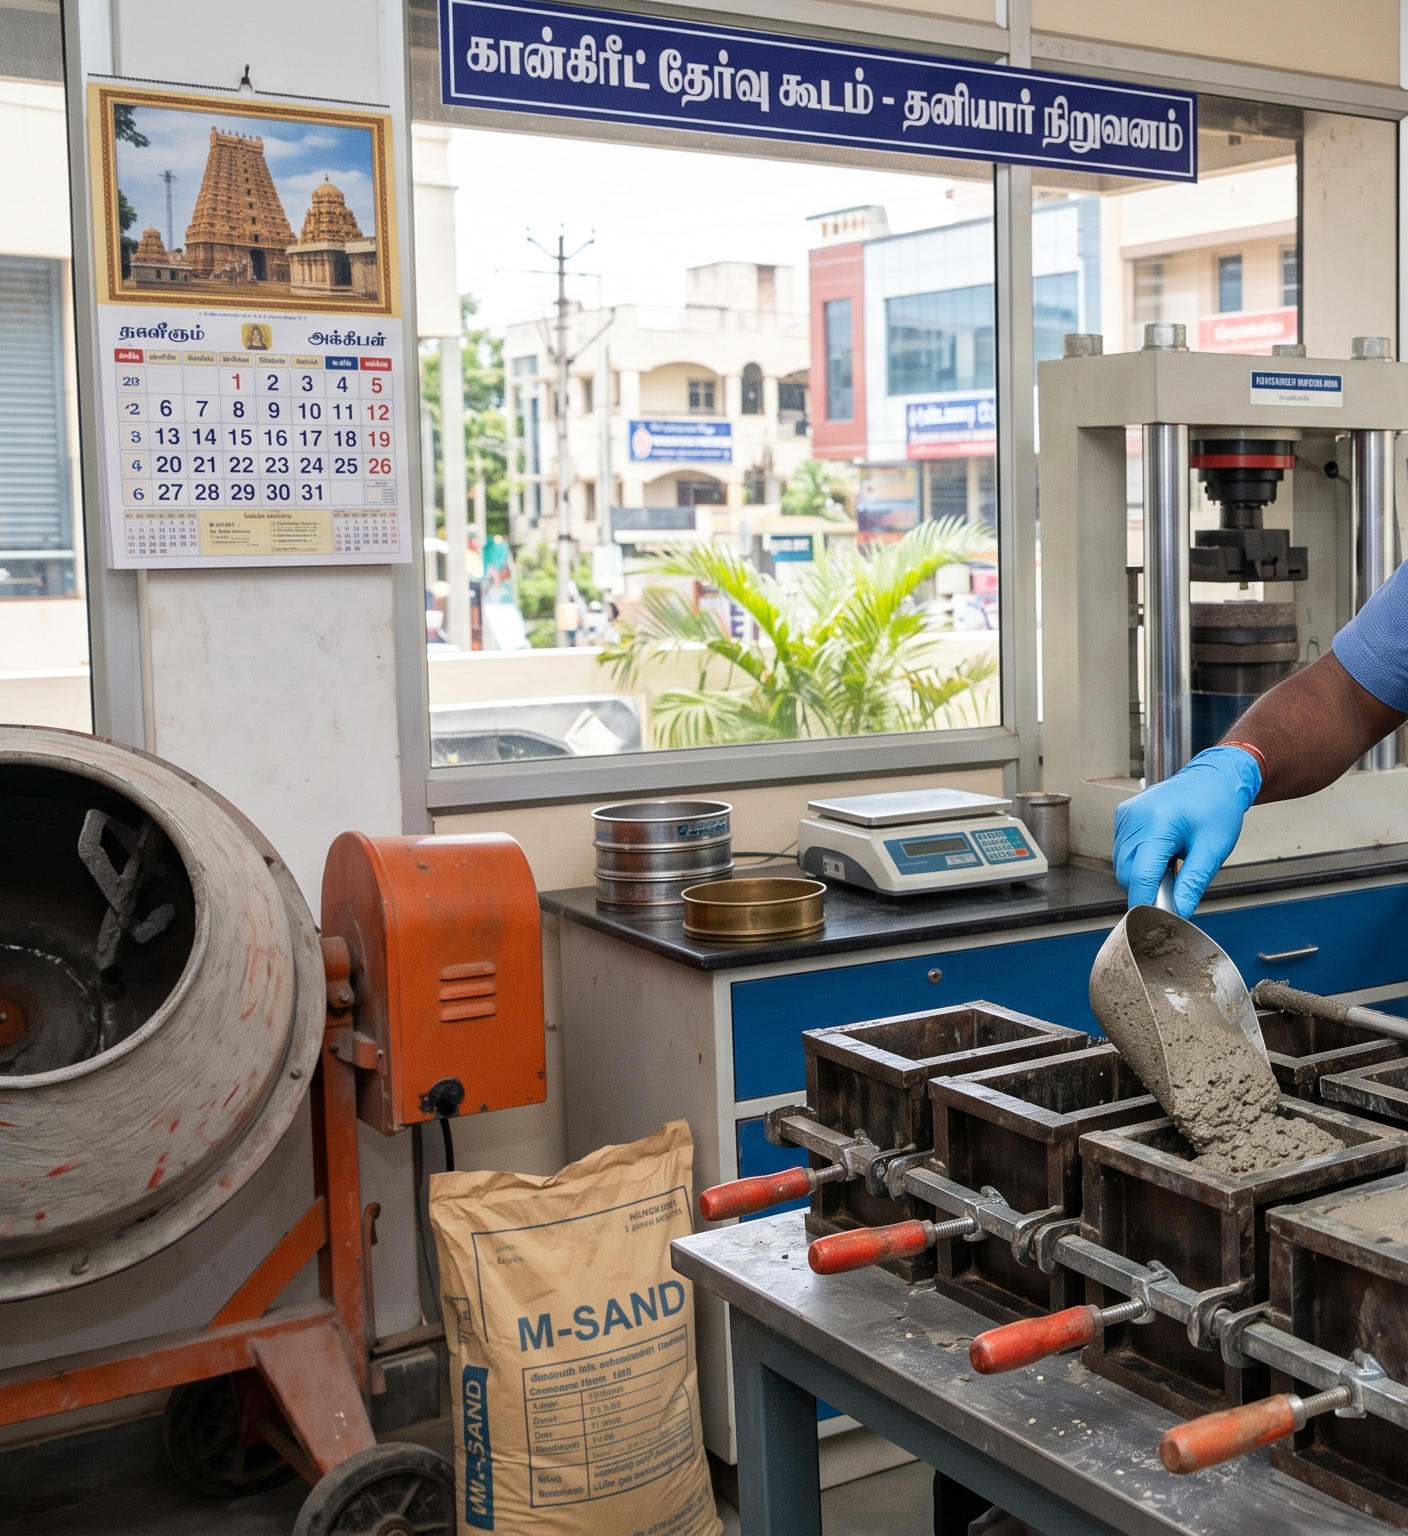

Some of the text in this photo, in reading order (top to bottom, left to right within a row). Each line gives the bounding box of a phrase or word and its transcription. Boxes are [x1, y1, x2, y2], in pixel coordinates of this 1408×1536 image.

[466, 26, 650, 90] கான்கிரீட்
[659, 48, 770, 112] தேர்வு
[779, 67, 874, 115] கூடம்
[902, 82, 1036, 135] தனியார்
[1042, 95, 1183, 153] நிறுவனம்
[232, 374, 240, 390] 1
[267, 374, 279, 390] 2
[302, 375, 313, 392] 3
[337, 377, 348, 392] 4
[371, 377, 382, 393] 5
[160, 400, 172, 417] 6
[196, 401, 208, 417] 7
[233, 401, 244, 418] 8
[268, 402, 280, 418] 9
[298, 403, 321, 419] 10
[333, 404, 352, 420] 11
[367, 404, 389, 420] 12
[155, 428, 180, 445] 13
[192, 428, 216, 445] 14
[228, 429, 252, 445] 15
[264, 430, 287, 446] 16
[299, 430, 322, 446] 17
[334, 430, 356, 447] 18
[368, 431, 390, 447] 19
[156, 456, 182, 473] 20
[194, 456, 215, 473] 21
[229, 457, 254, 473] 22
[265, 457, 289, 473] 23
[300, 457, 323, 474] 24
[335, 458, 358, 474] 25
[368, 458, 392, 474] 26
[158, 484, 183, 500] 27
[195, 484, 219, 500] 28
[231, 484, 255, 501] 29
[266, 484, 290, 500] 30
[302, 484, 322, 500] 31
[518, 1279, 686, 1352] M-SAND
